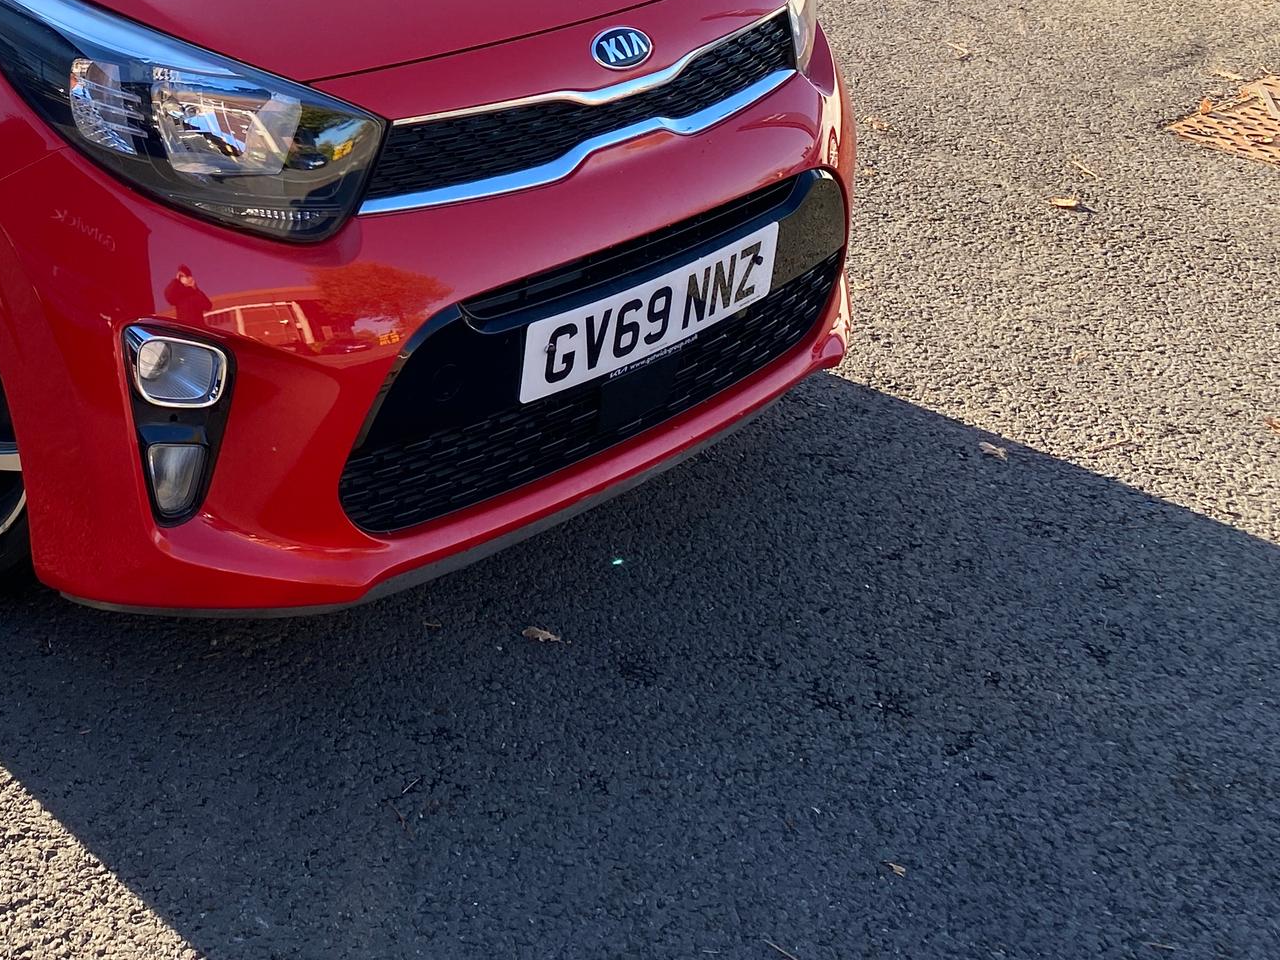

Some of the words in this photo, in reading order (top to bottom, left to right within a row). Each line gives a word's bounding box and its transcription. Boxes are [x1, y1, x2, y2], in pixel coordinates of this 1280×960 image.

[600, 32, 648, 63] KIA
[545, 286, 673, 383] GV69
[682, 241, 762, 330] NNZ
